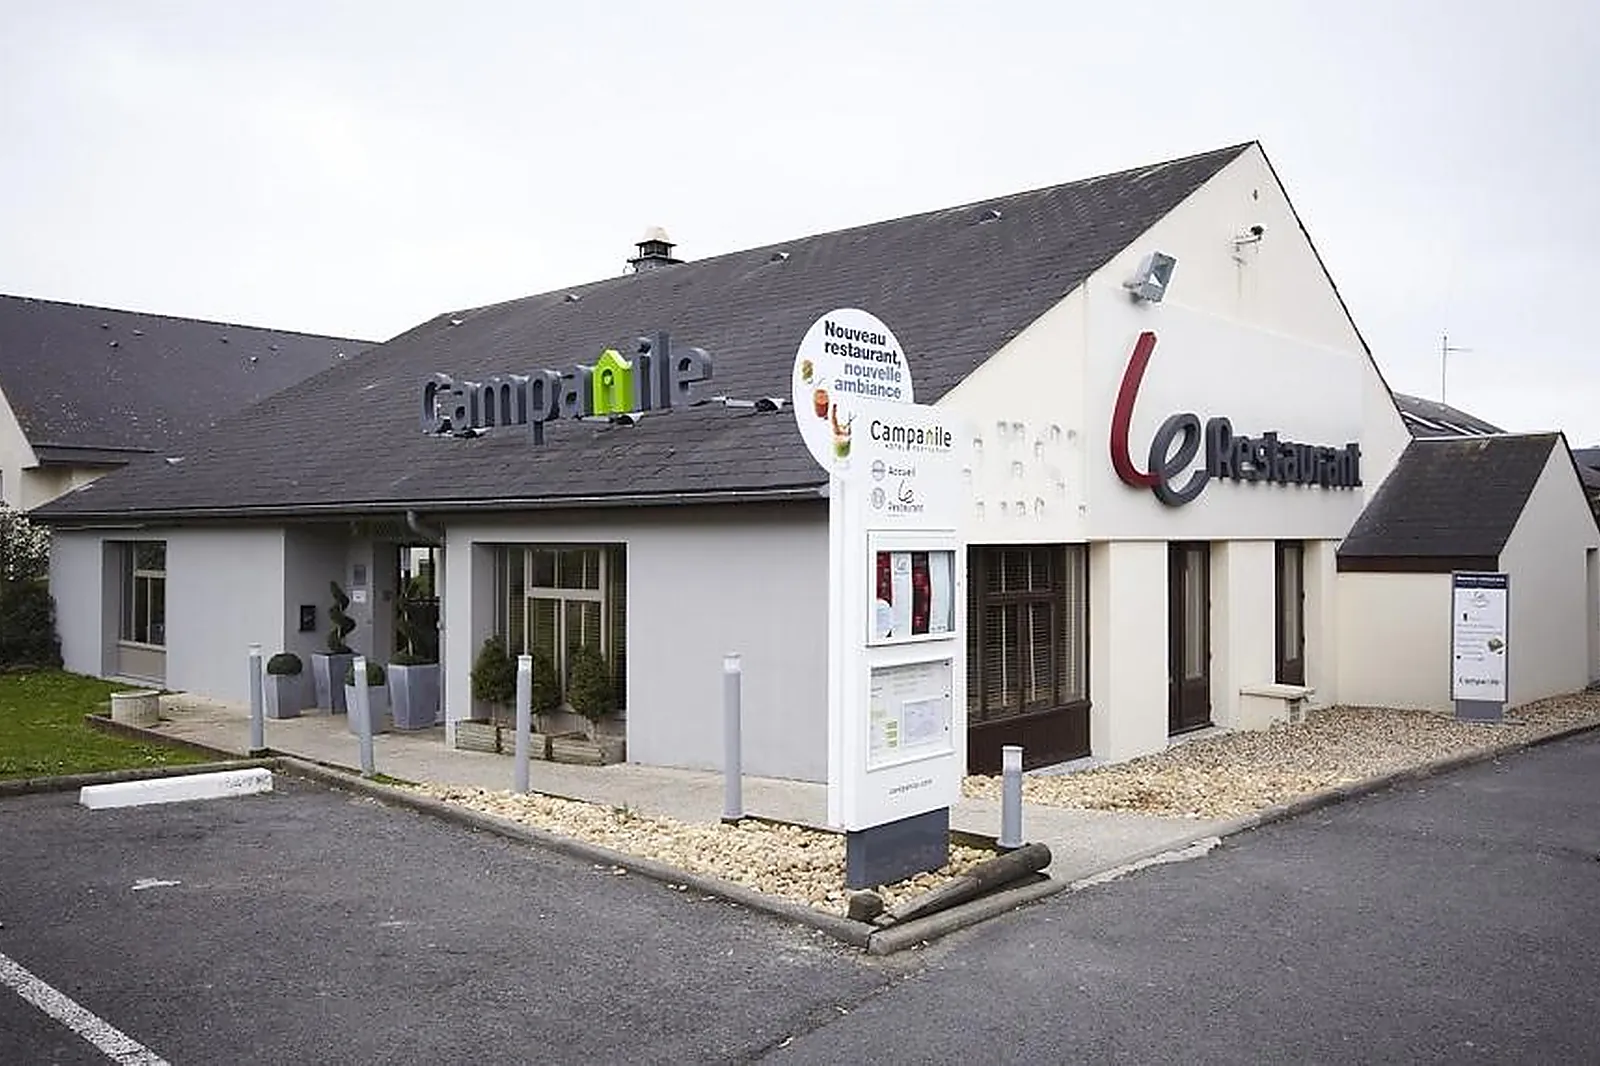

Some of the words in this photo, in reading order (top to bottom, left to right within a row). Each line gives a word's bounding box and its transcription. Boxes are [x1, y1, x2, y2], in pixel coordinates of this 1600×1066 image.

[824, 320, 887, 346] Nouveau
[824, 342, 902, 367] restaurant,
[844, 361, 902, 383] nouvelle
[420, 331, 713, 446] Campanile
[834, 377, 902, 399] ambiance
[870, 420, 952, 449] Campanile
[1206, 417, 1362, 488] Restaurant
